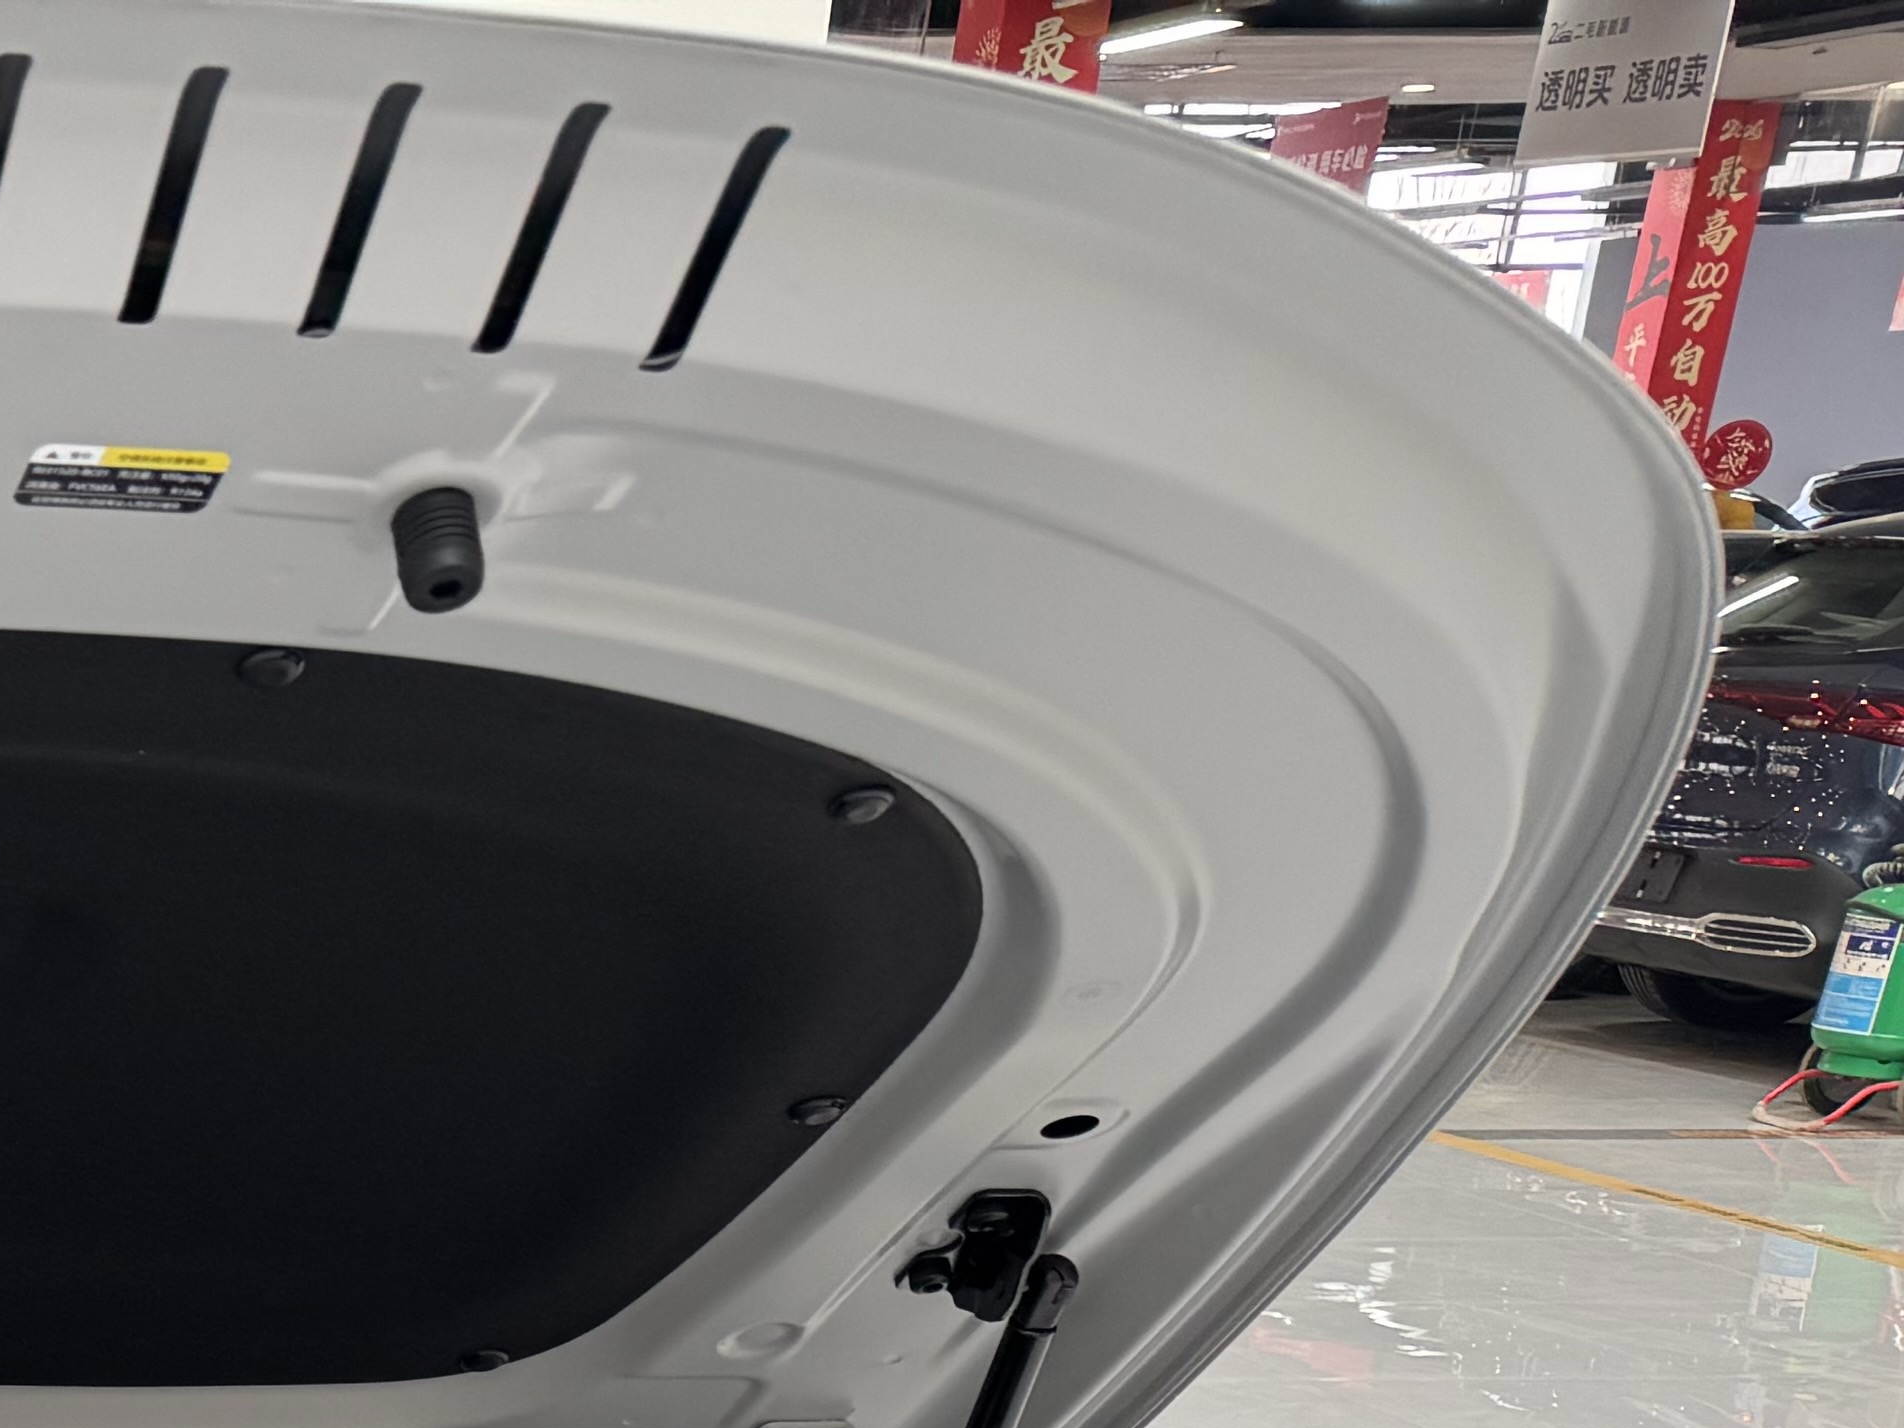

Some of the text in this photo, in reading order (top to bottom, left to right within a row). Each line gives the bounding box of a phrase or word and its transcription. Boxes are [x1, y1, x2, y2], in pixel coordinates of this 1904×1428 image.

[1019, 17, 1078, 83] 最
[1536, 53, 1709, 112] 透明买 透明卖
